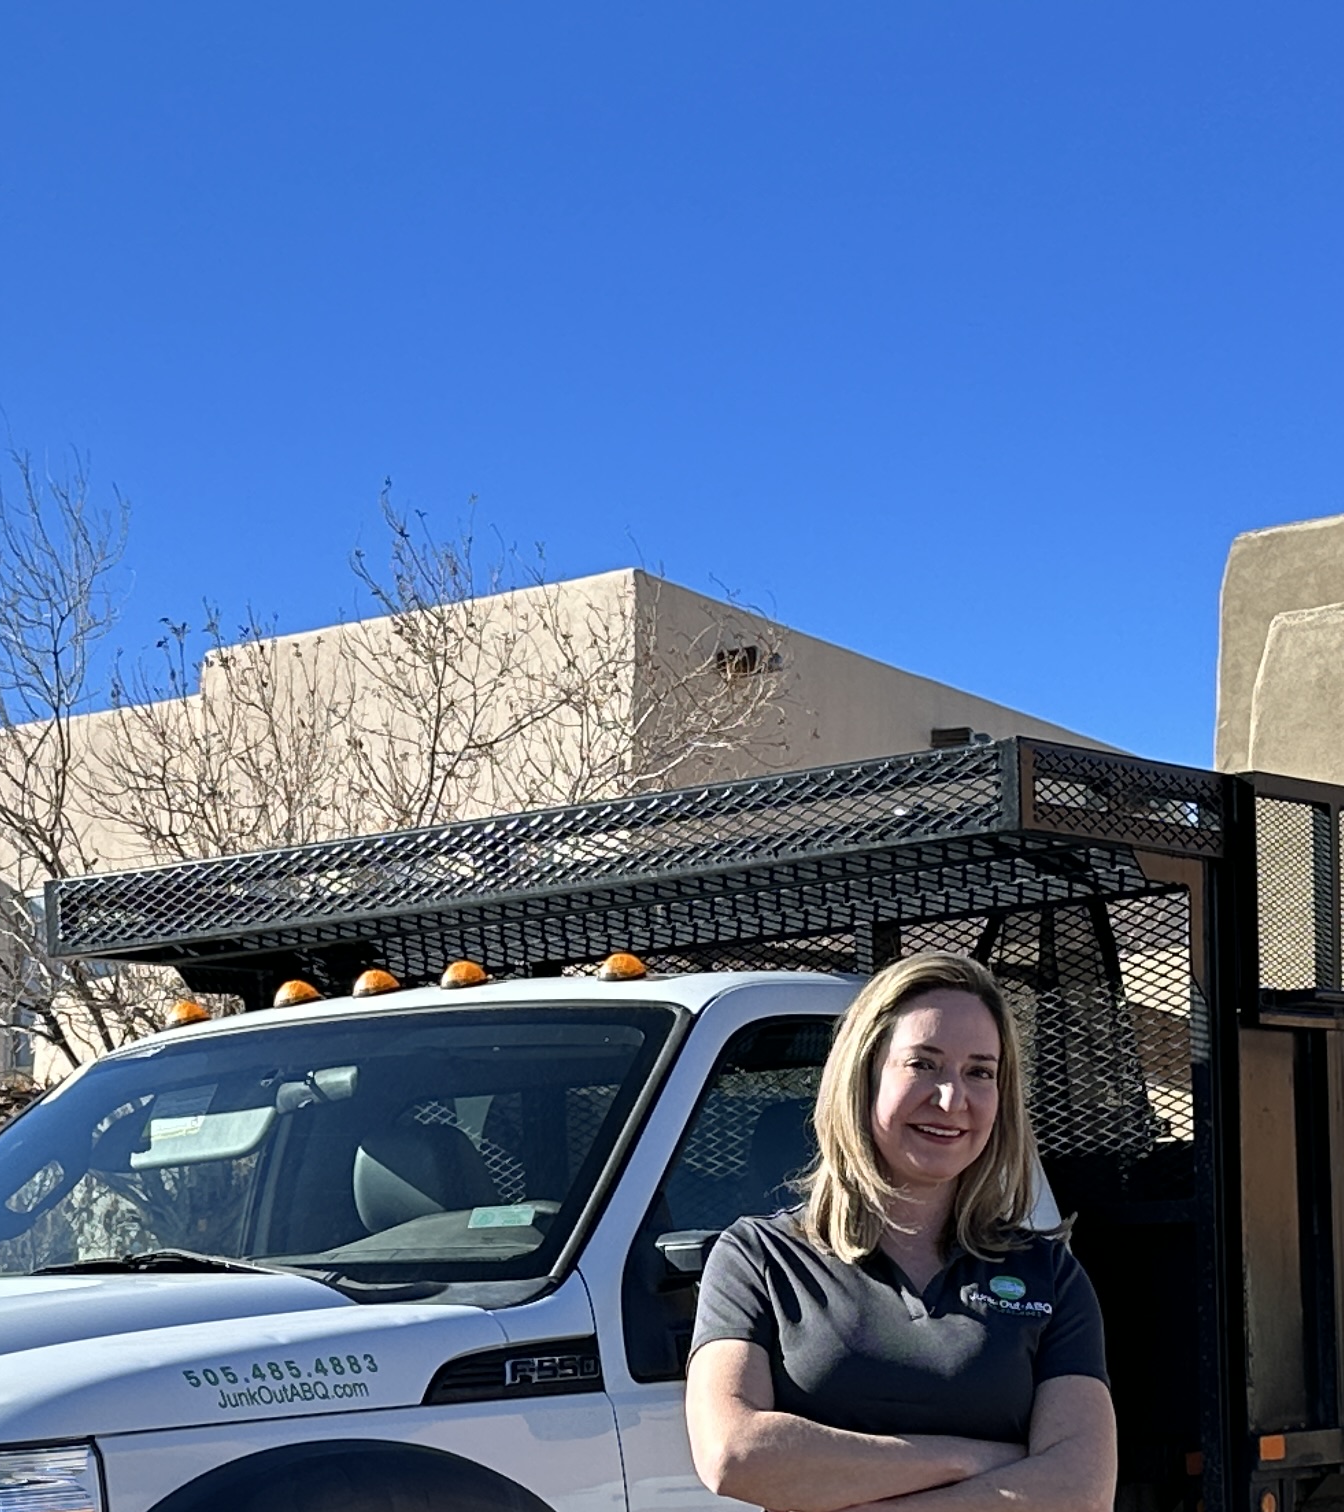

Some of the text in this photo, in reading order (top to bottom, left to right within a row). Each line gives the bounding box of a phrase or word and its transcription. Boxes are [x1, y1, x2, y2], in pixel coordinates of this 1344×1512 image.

[182, 1353, 379, 1389] 505.485.4883
[504, 1355, 600, 1386] F-550
[217, 1380, 370, 1410] JunkOutABQ.com
